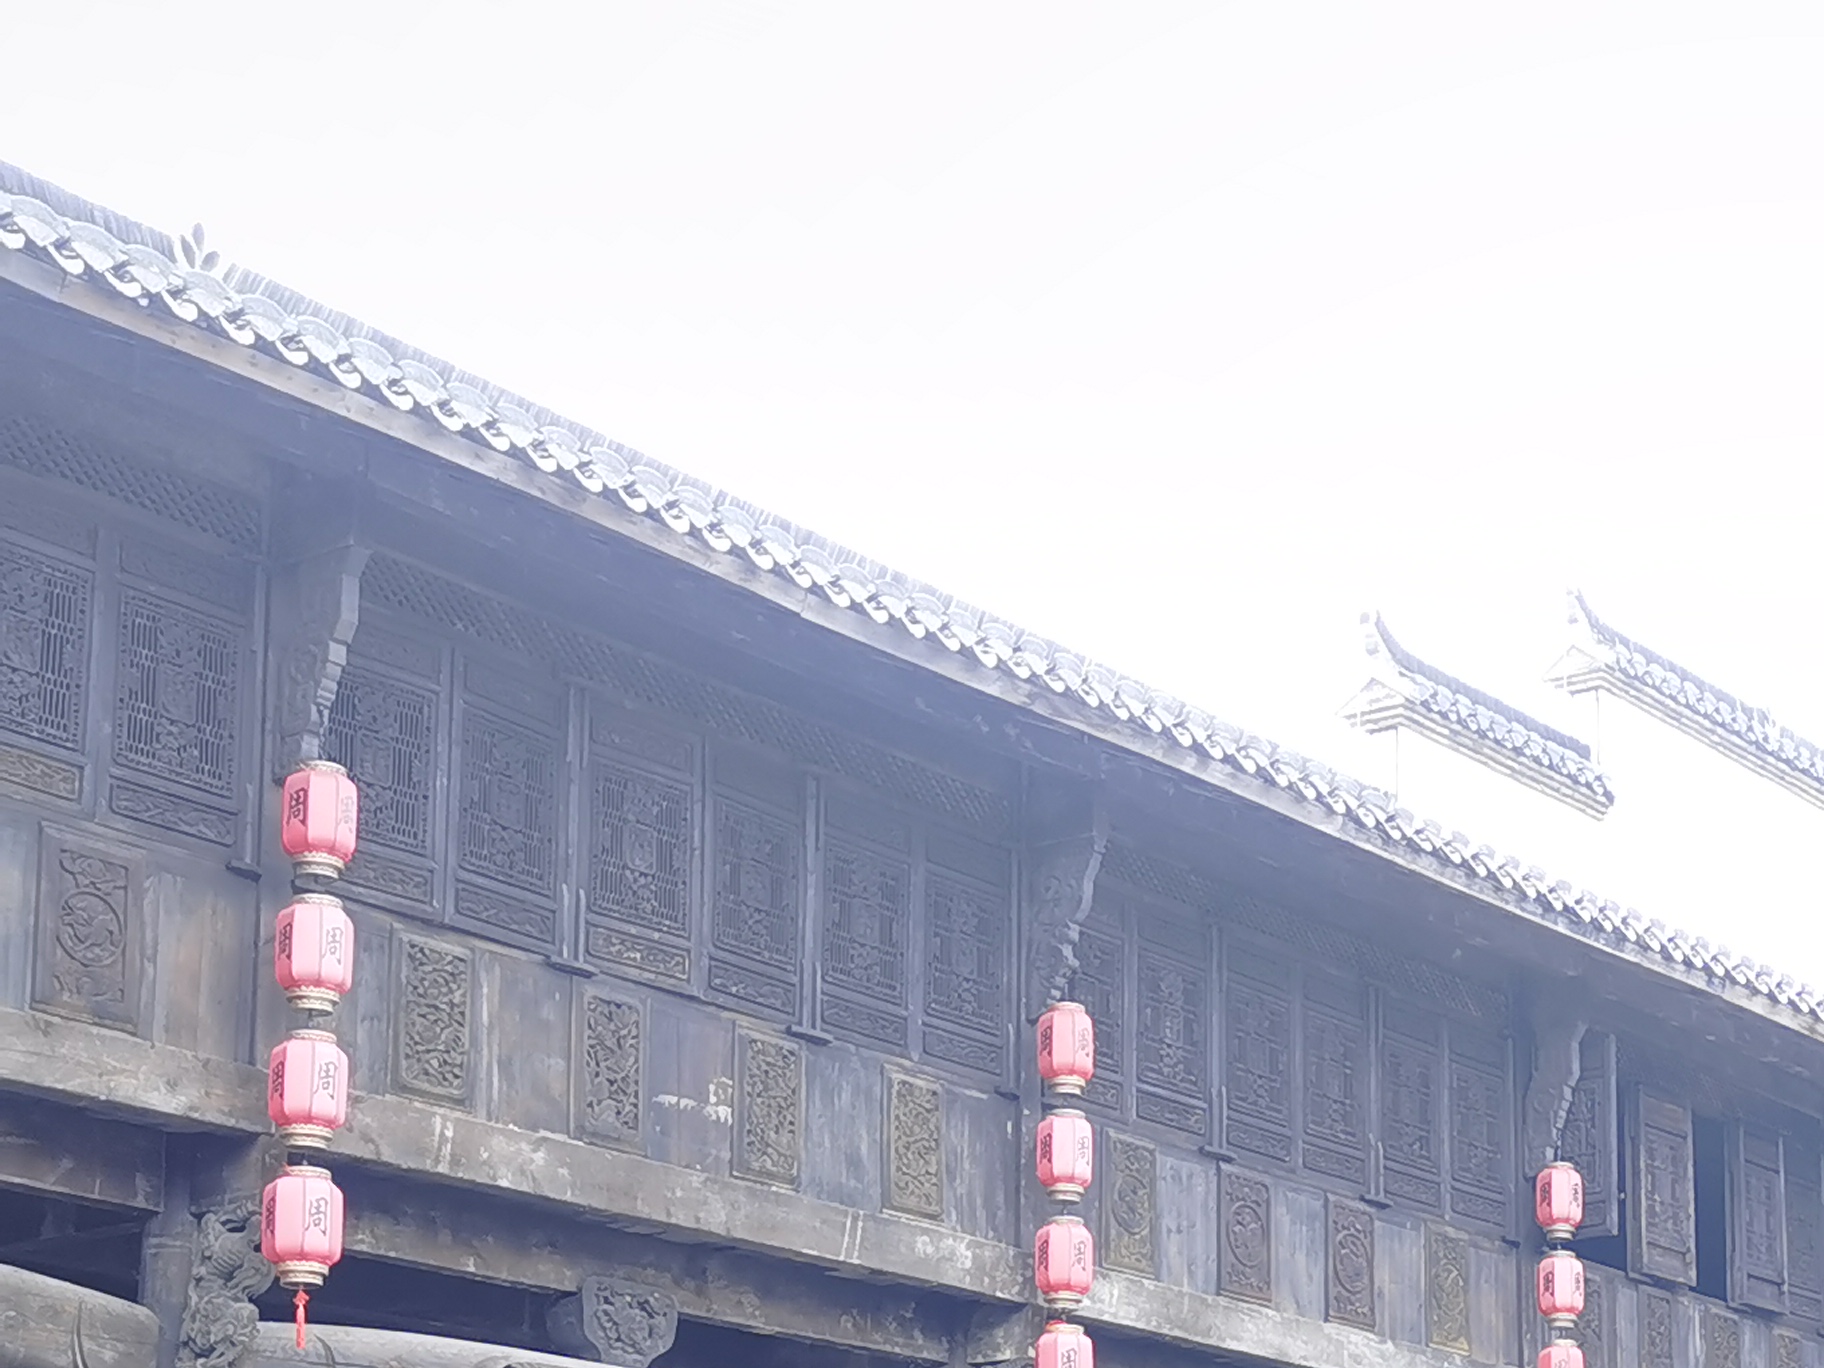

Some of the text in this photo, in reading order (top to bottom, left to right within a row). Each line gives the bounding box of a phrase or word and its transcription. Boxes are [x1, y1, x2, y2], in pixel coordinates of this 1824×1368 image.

[286, 787, 307, 827] 周
[322, 926, 344, 965] 周
[313, 1061, 338, 1100] 周
[1075, 1135, 1090, 1167] 周
[305, 1196, 328, 1237] 周
[1072, 1240, 1086, 1272] 周
